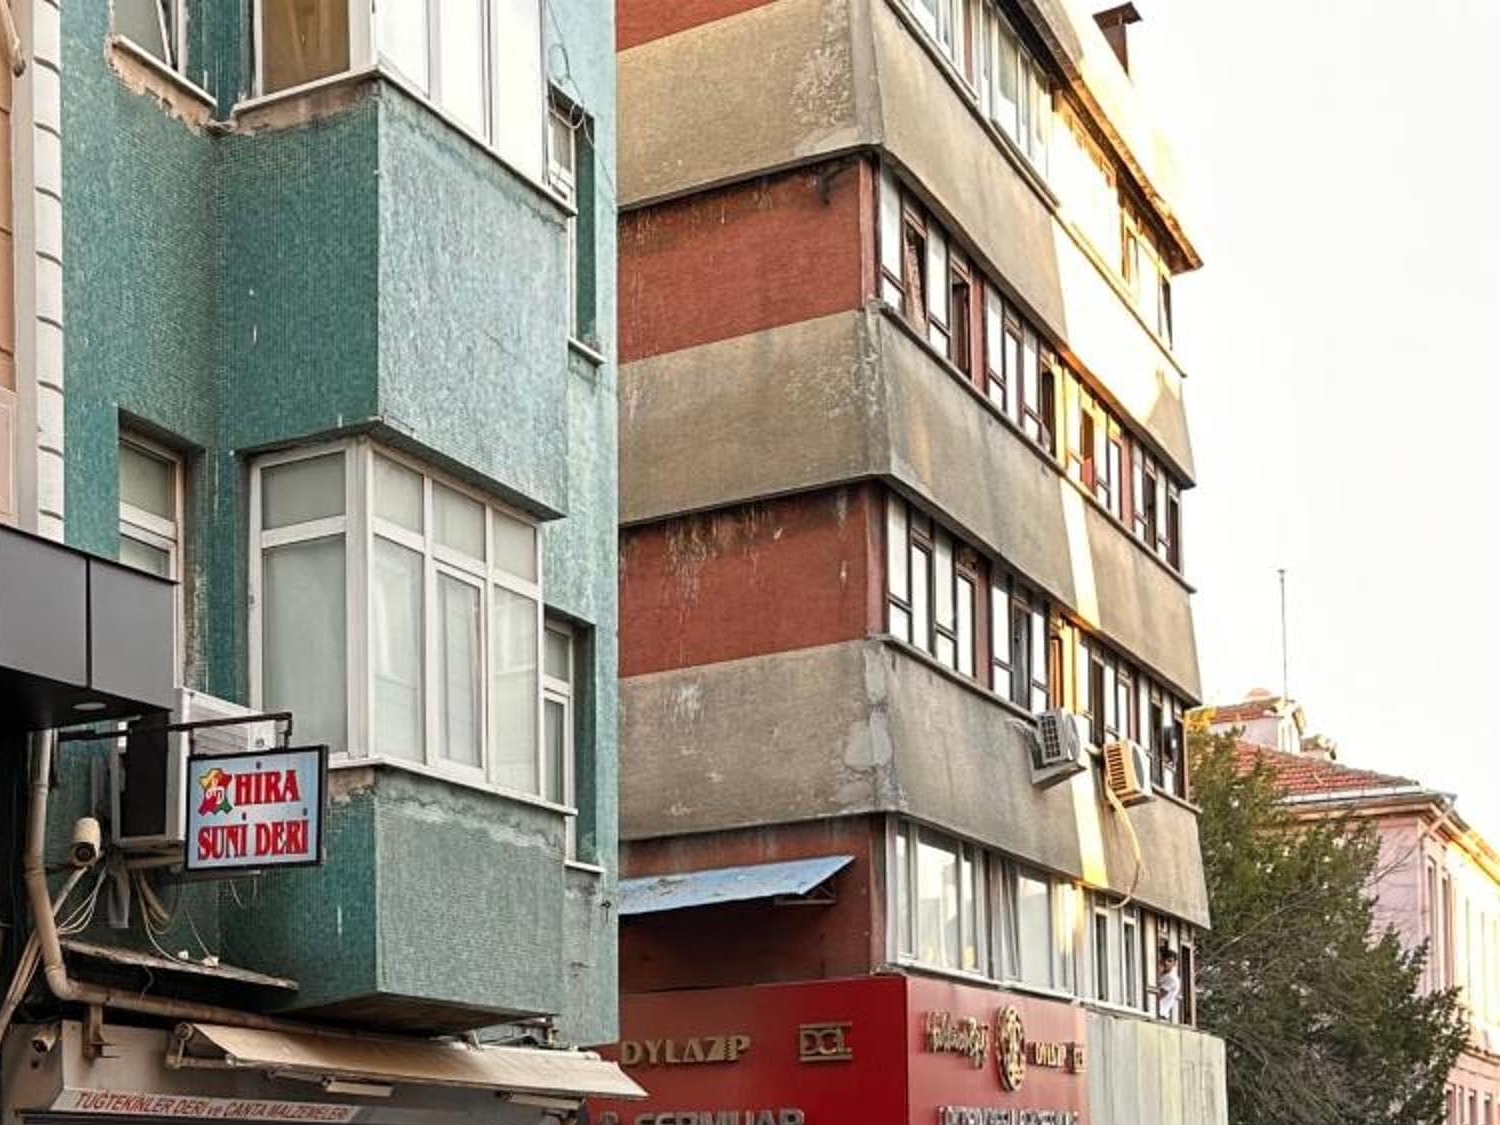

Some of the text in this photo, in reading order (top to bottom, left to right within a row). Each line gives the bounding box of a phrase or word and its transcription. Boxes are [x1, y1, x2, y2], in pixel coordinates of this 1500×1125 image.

[234, 761, 301, 806] HİRA
[197, 807, 309, 861] SUNİ DERİ
